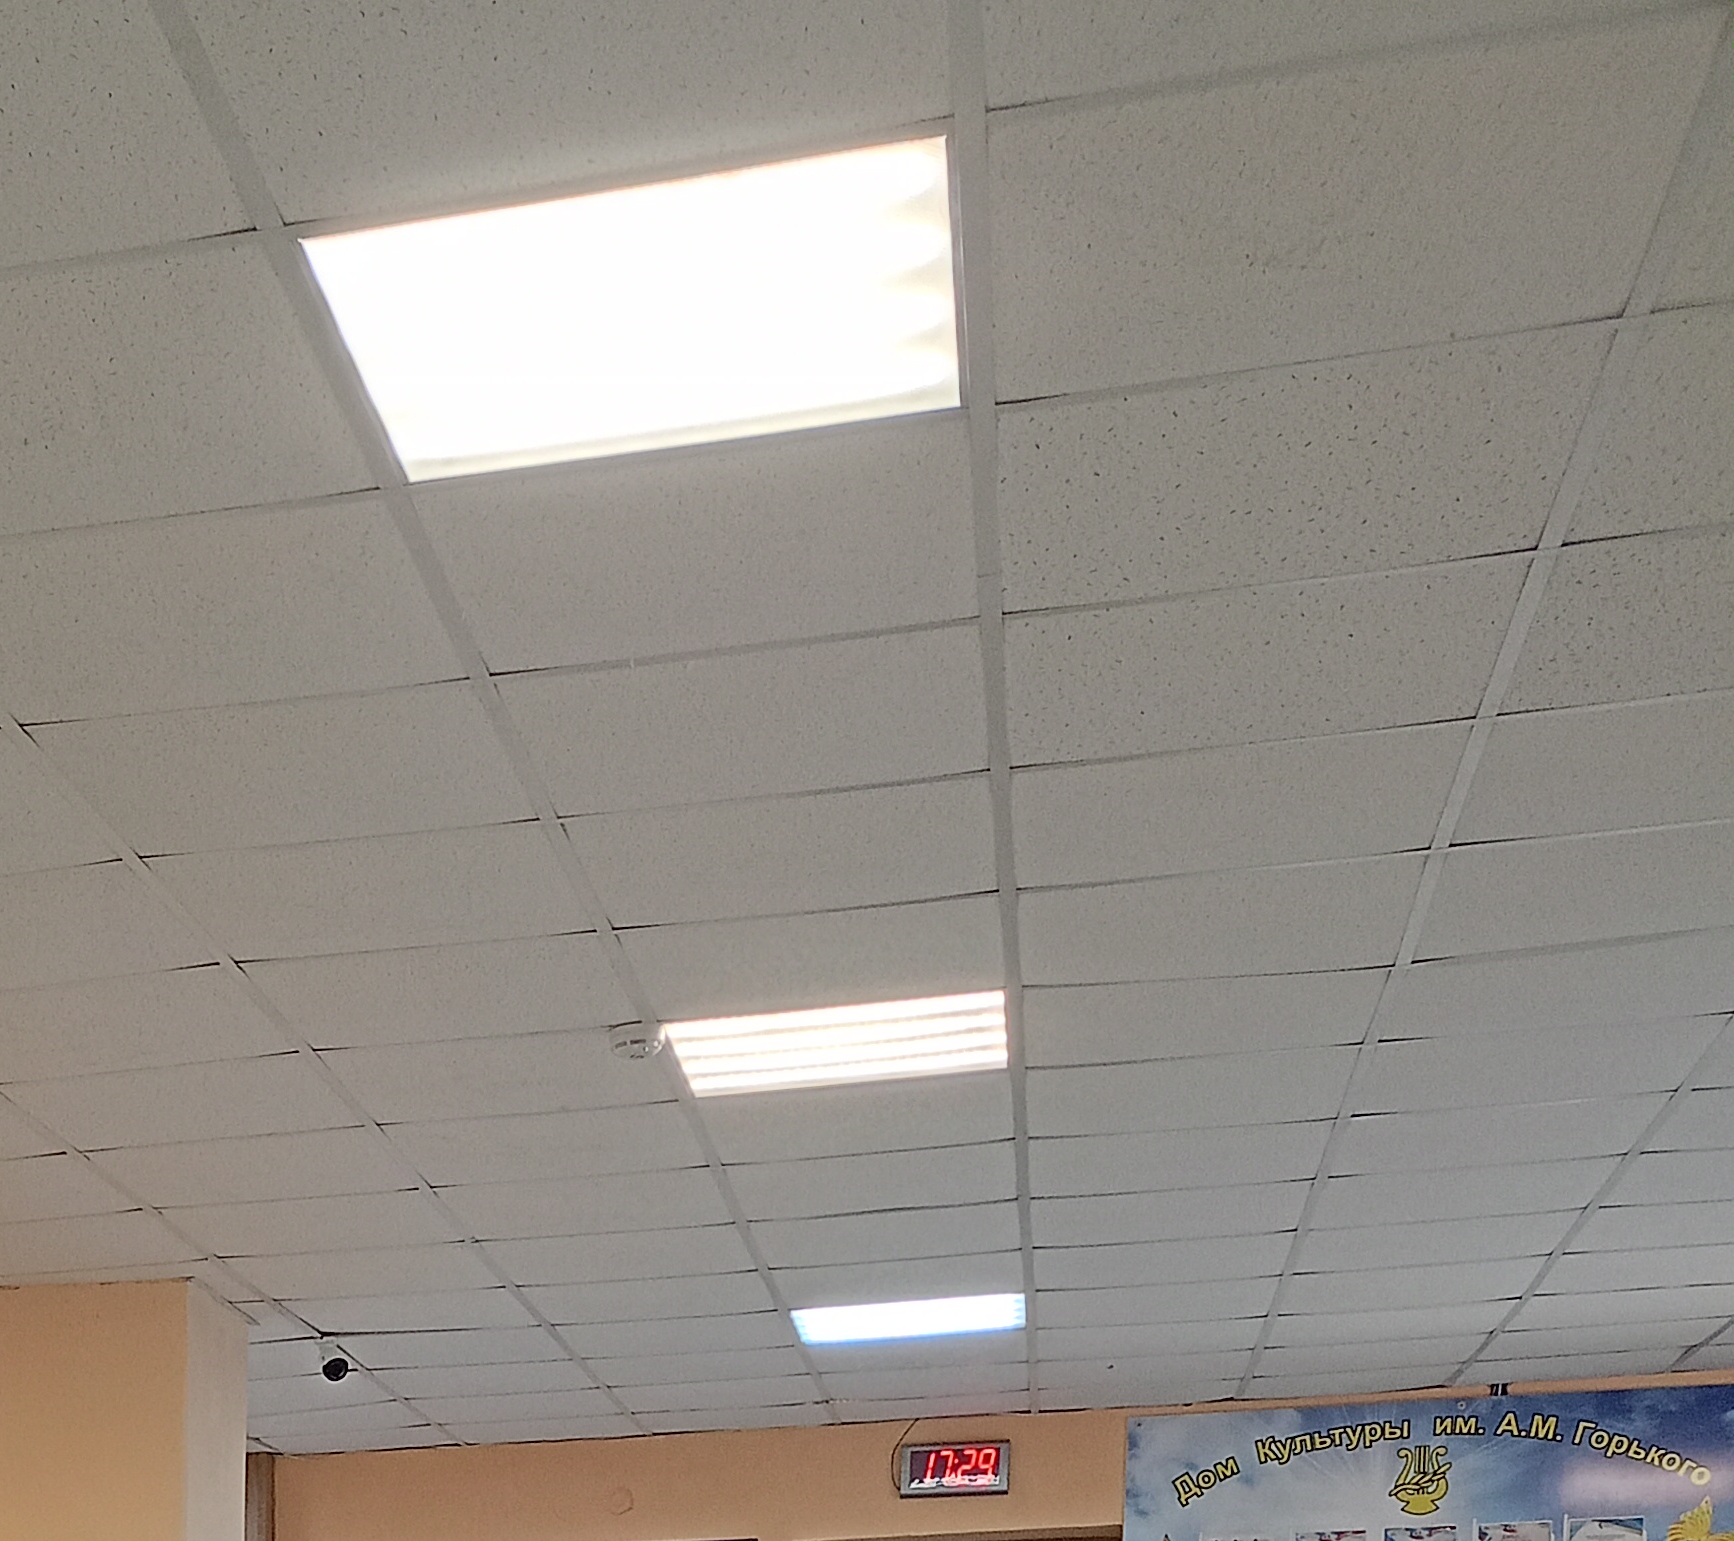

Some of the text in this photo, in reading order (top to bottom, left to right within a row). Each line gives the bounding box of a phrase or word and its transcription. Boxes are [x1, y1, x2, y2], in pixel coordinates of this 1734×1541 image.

[923, 1448, 996, 1484] 17:29
[1170, 1411, 1713, 1506] Дом Культуры им. А.М. Горького
